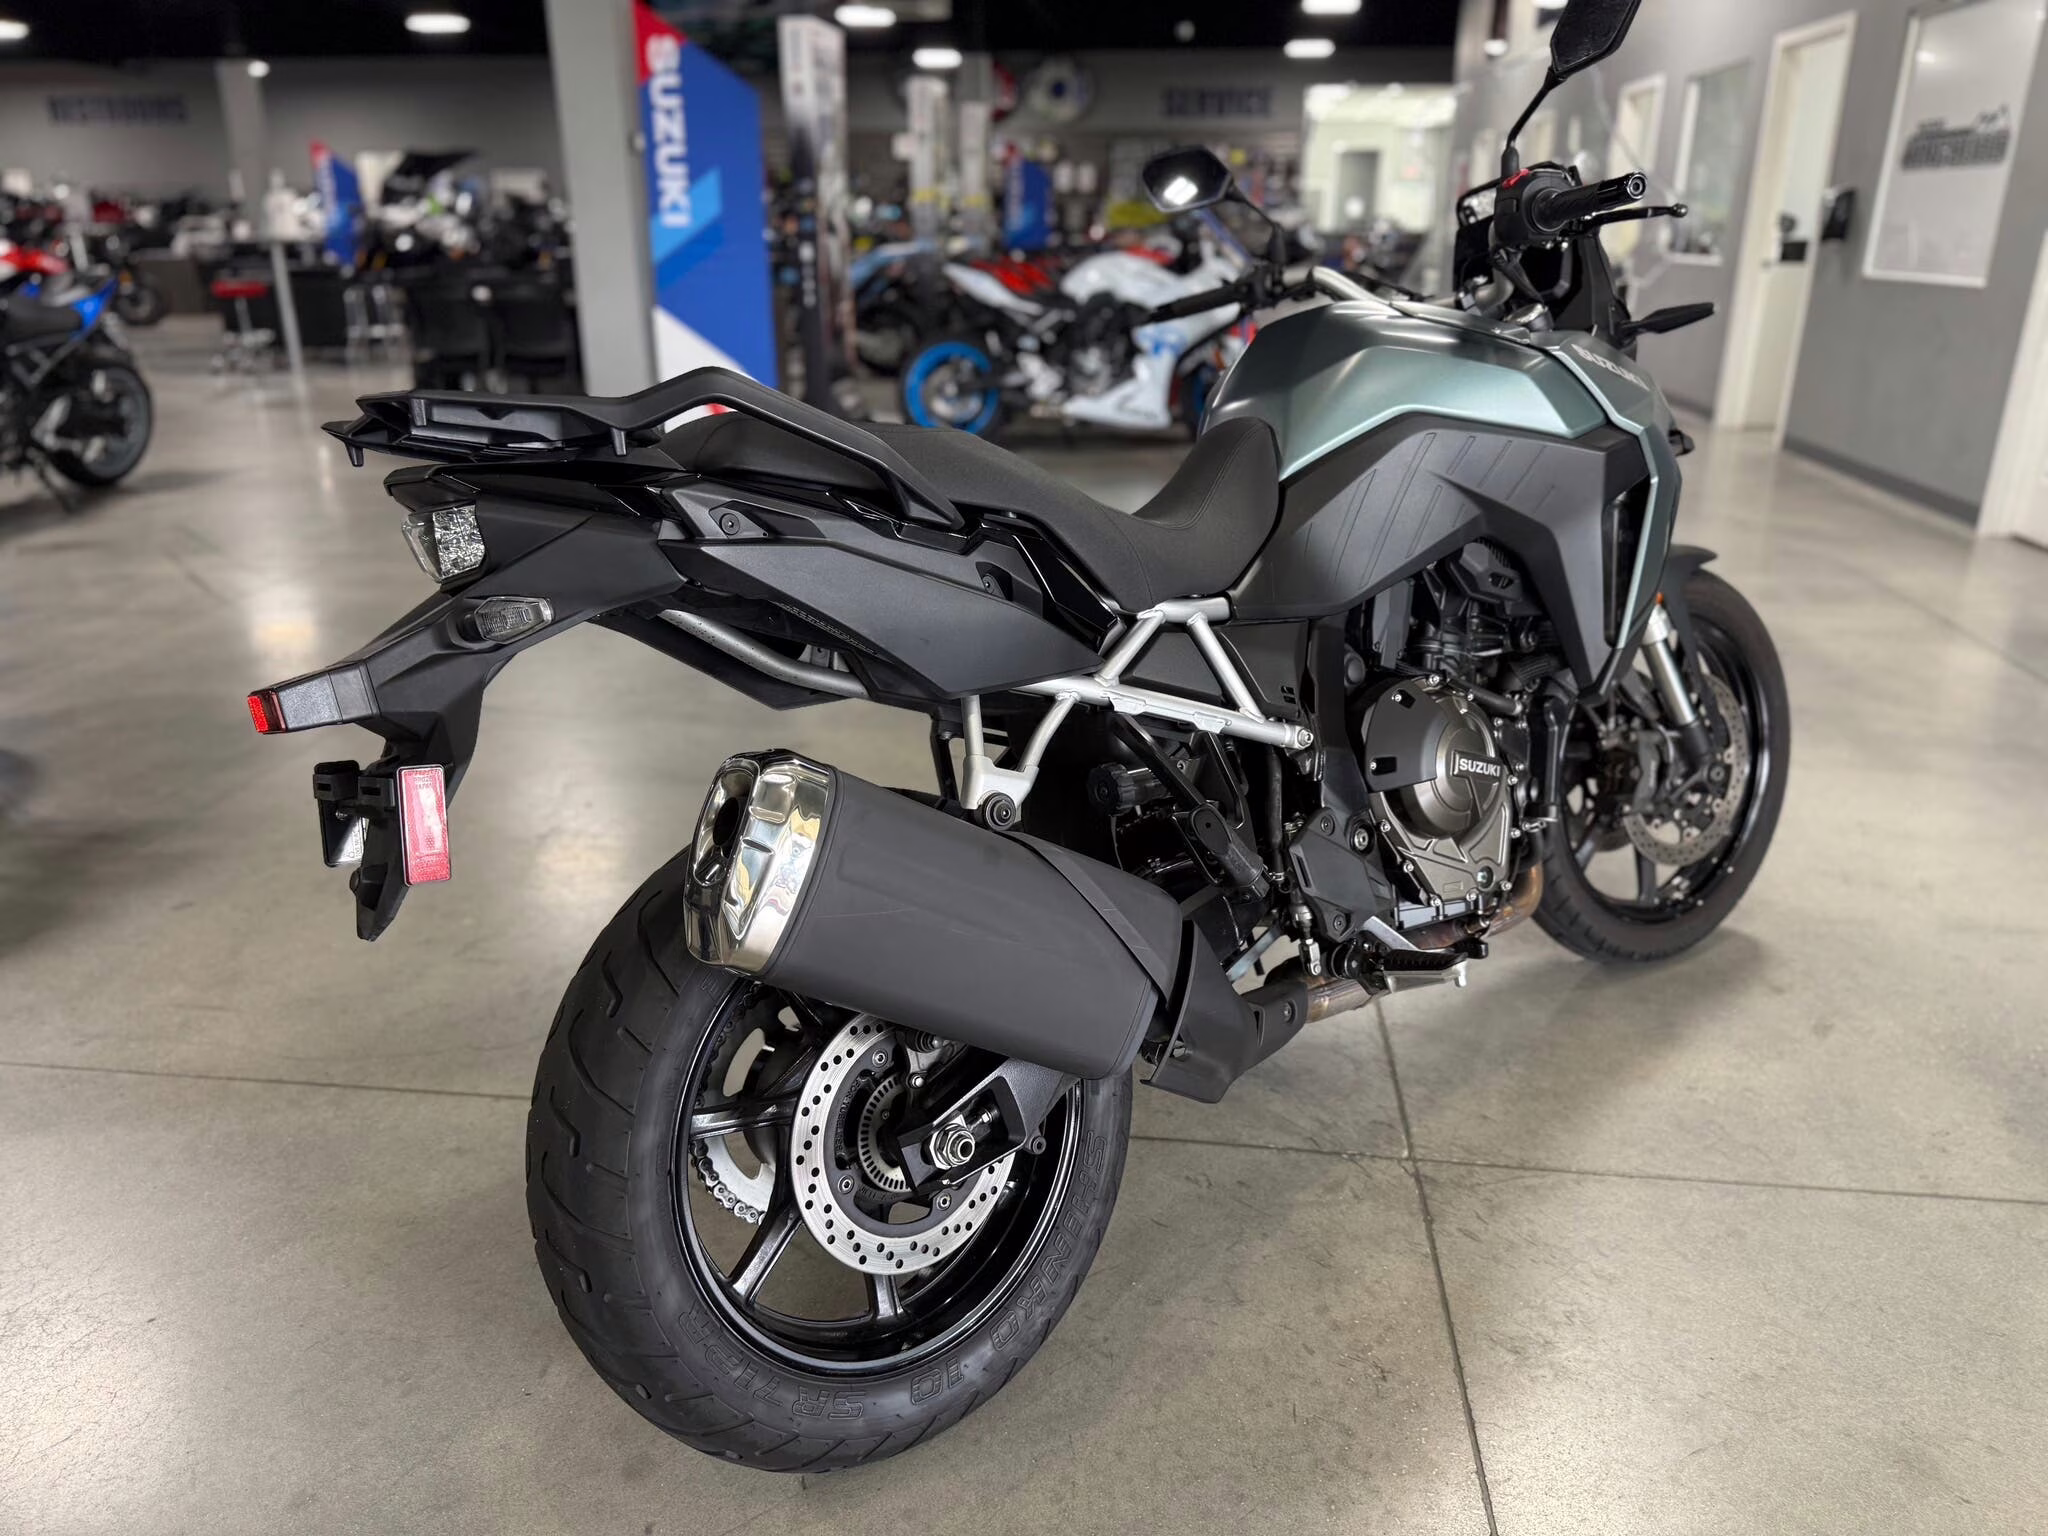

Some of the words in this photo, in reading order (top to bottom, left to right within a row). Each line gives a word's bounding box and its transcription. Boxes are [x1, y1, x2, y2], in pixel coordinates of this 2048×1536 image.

[645, 33, 693, 229] SUZUKI
[1570, 343, 1650, 392] SUZUKI
[1459, 758, 1501, 777] SUZUKI
[990, 1130, 1107, 1351] SHINKO
